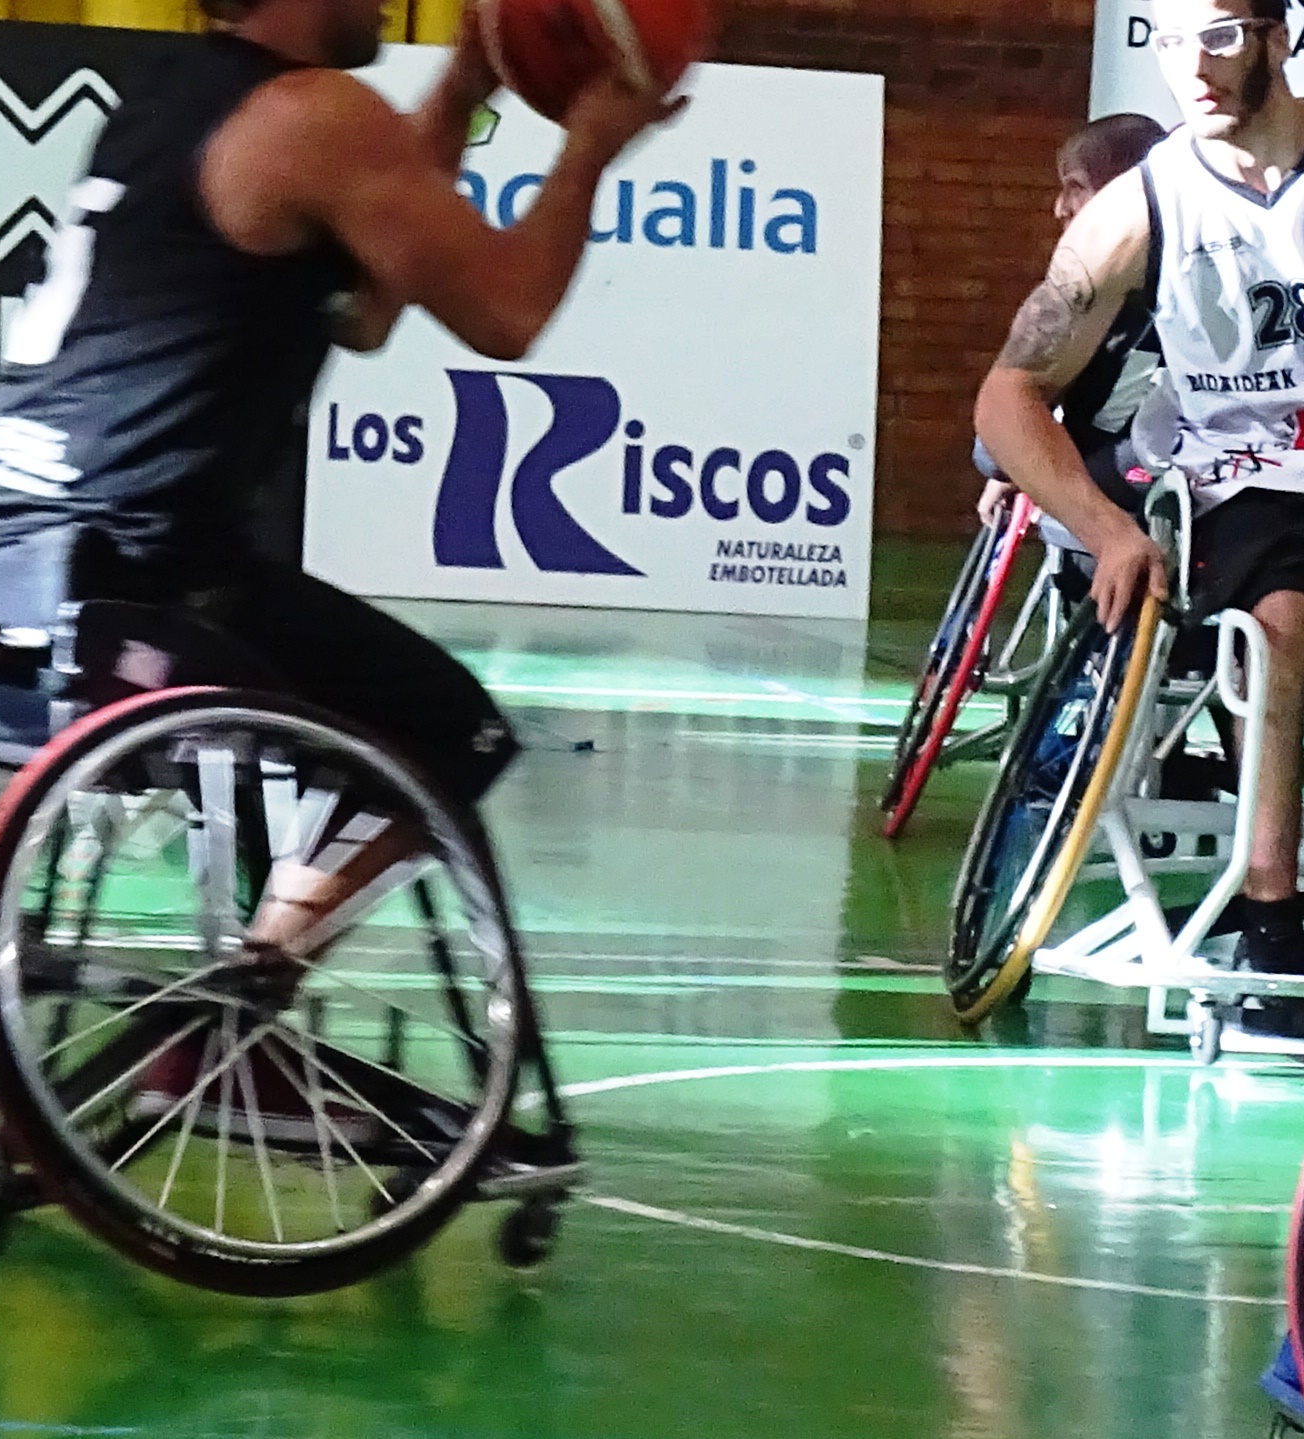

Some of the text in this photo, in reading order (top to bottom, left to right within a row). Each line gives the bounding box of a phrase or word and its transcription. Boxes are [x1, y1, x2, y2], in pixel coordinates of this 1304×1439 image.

[1127, 16, 1152, 48] D
[716, 539, 843, 564] NATURALEZA
[708, 562, 848, 588] EMBOTELLADA
